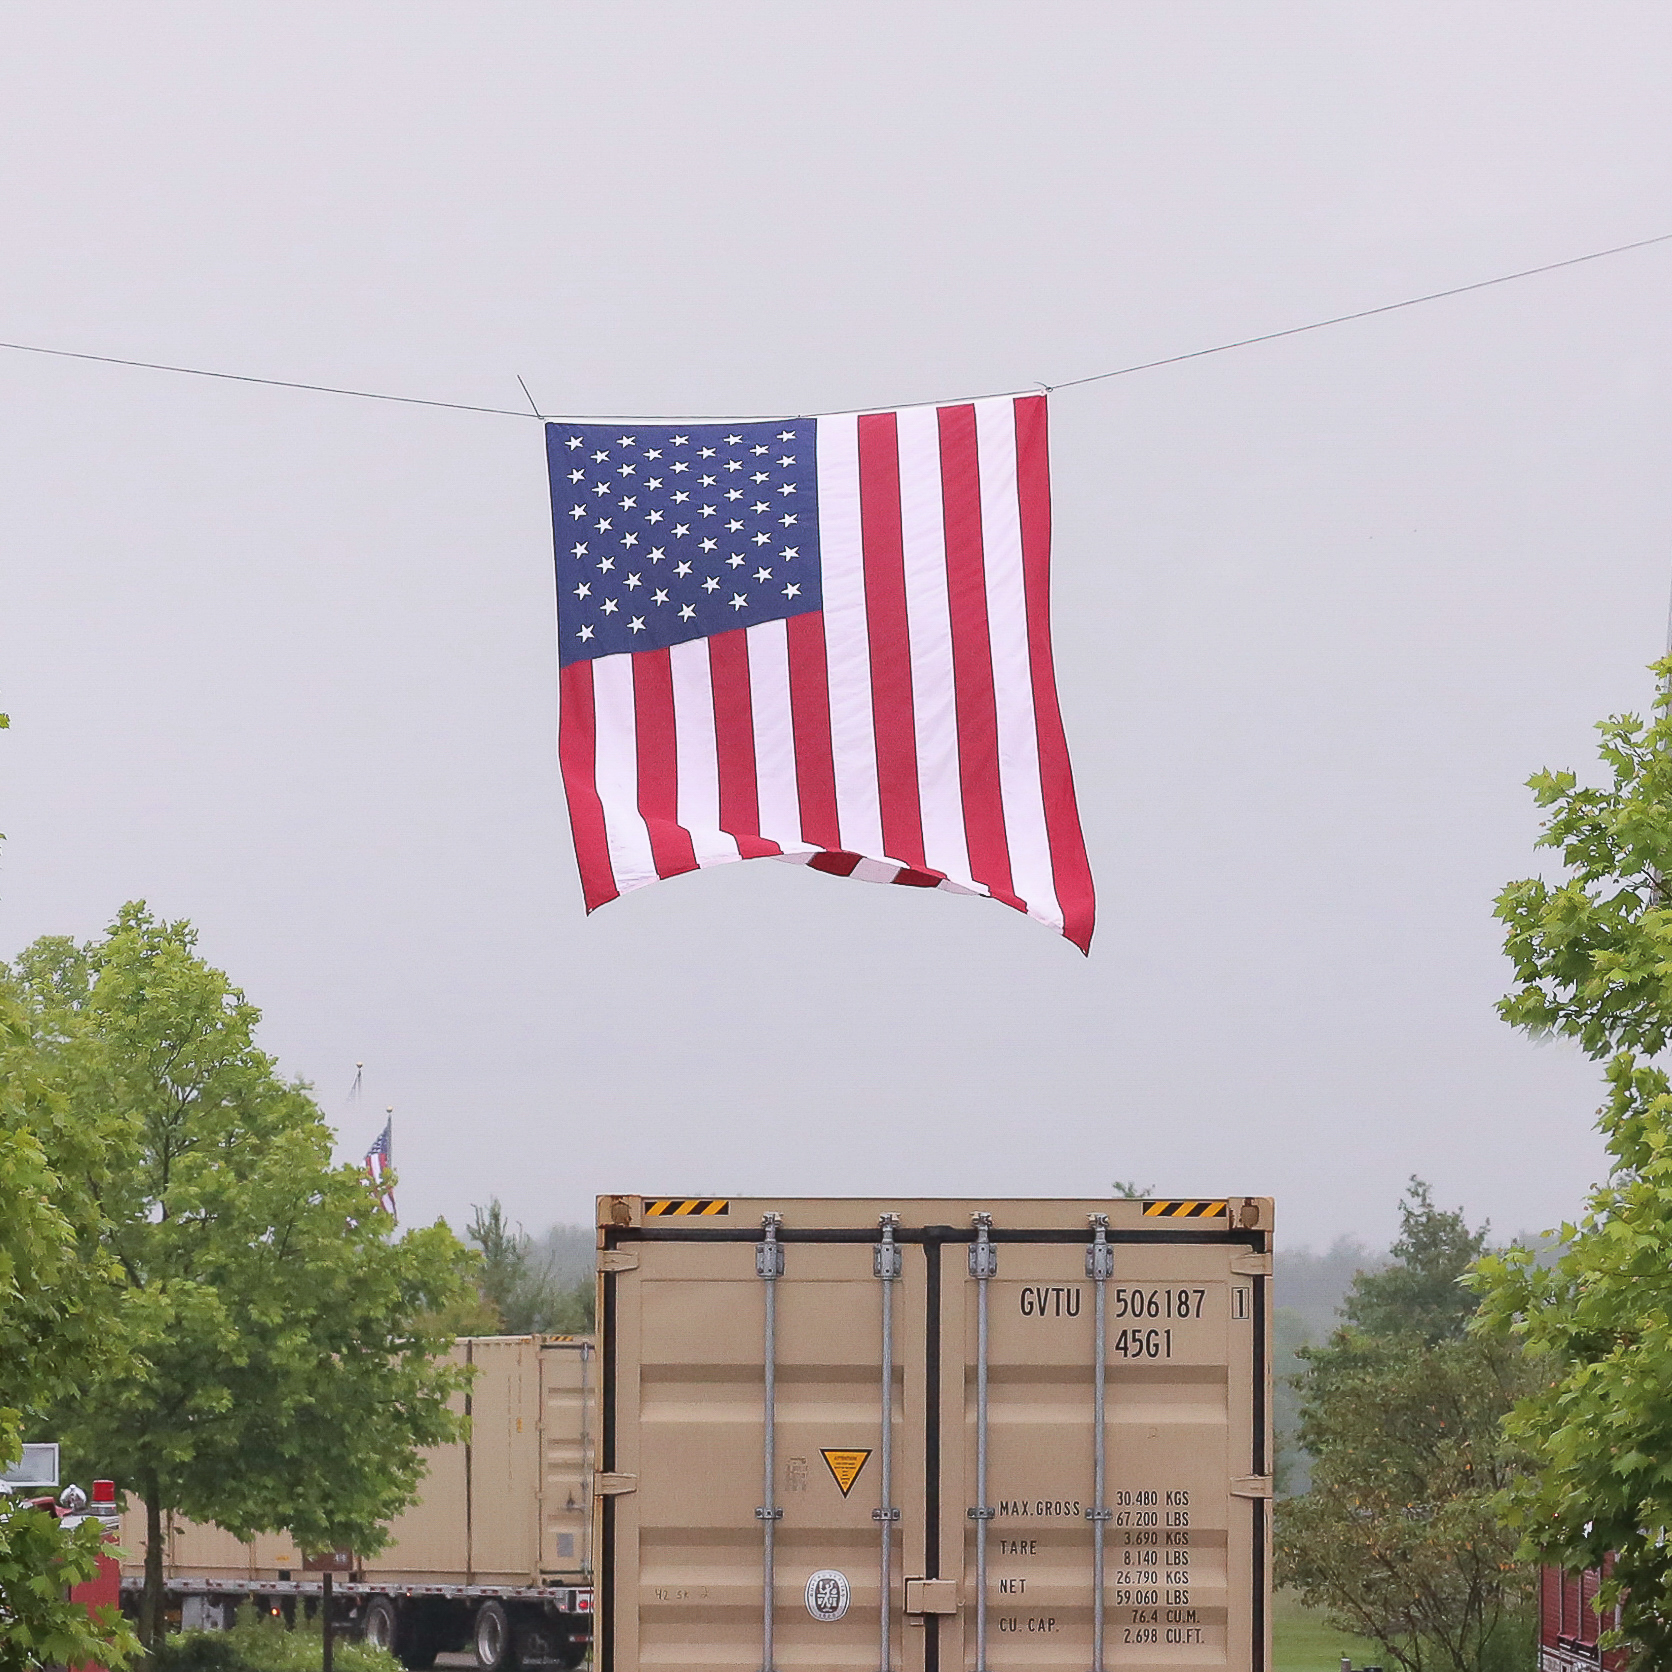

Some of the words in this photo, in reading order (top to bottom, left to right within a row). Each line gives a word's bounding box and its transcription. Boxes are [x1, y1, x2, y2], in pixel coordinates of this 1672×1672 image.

[1020, 1287, 1081, 1317] GVTU
[1115, 1289, 1206, 1318] 506187
[1115, 1329, 1172, 1358] 45G1
[1116, 1491, 1158, 1506] 30.480
[1166, 1491, 1189, 1506] KGS
[1116, 1512, 1158, 1527] 67.200
[1166, 1512, 1189, 1527] LBS
[1124, 1532, 1158, 1546] 3.690
[1166, 1532, 1189, 1546] KGS
[1000, 1540, 1038, 1555] TARE
[1123, 1551, 1158, 1566] 8.140
[1166, 1551, 1189, 1566] LBS
[1116, 1571, 1158, 1585] 26.790
[1166, 1571, 1189, 1585] KGS
[999, 1579, 1027, 1594] NET
[1116, 1590, 1158, 1605] 59.060
[1166, 1590, 1189, 1605] LBS
[1132, 1609, 1158, 1624] 76.4
[1166, 1609, 1200, 1624] CU.M.
[999, 1618, 1023, 1632] CU.
[1028, 1618, 1060, 1632] CAP.
[1124, 1629, 1158, 1644] 2.698
[1166, 1629, 1205, 1644] CU.FT.
